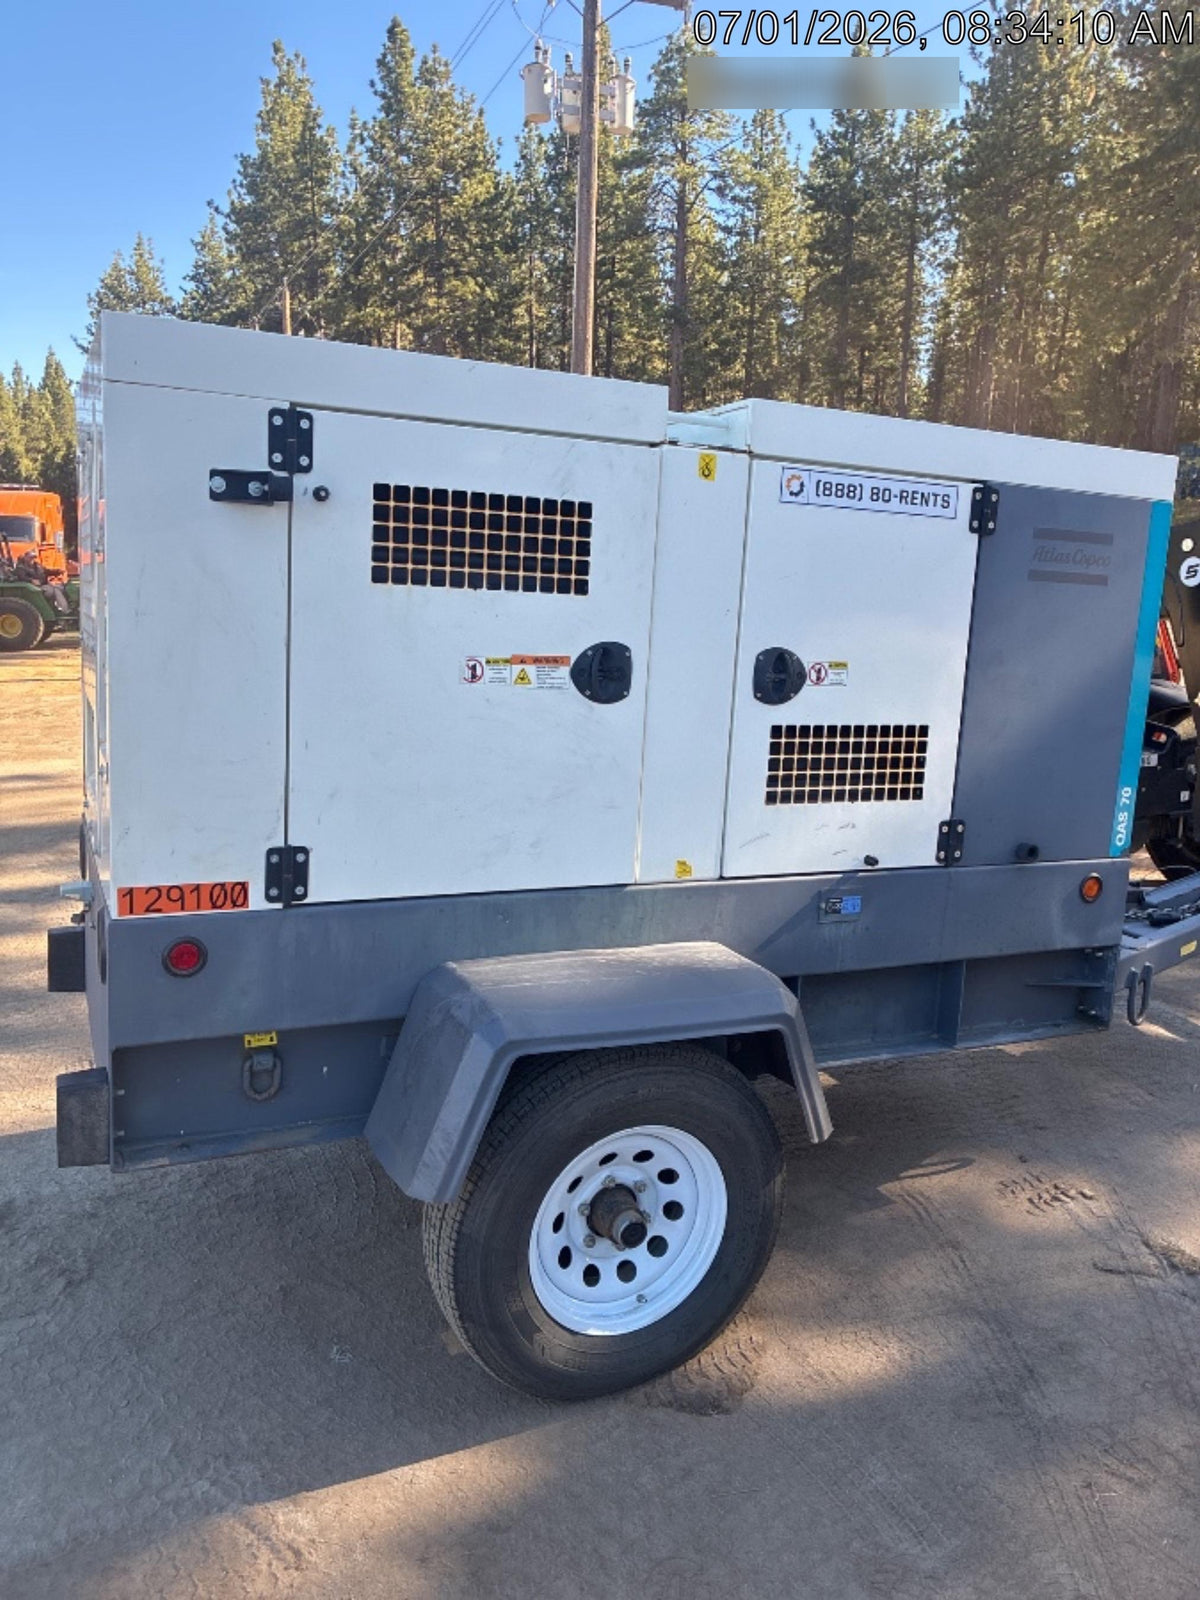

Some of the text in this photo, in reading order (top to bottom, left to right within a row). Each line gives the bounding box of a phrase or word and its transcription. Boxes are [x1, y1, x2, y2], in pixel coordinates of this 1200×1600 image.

[815, 479, 951, 509] (888) 80-RENTS
[1033, 545, 1111, 569] Atlas Copco
[1115, 786, 1132, 847] QAS 70
[122, 881, 248, 915] 129100
